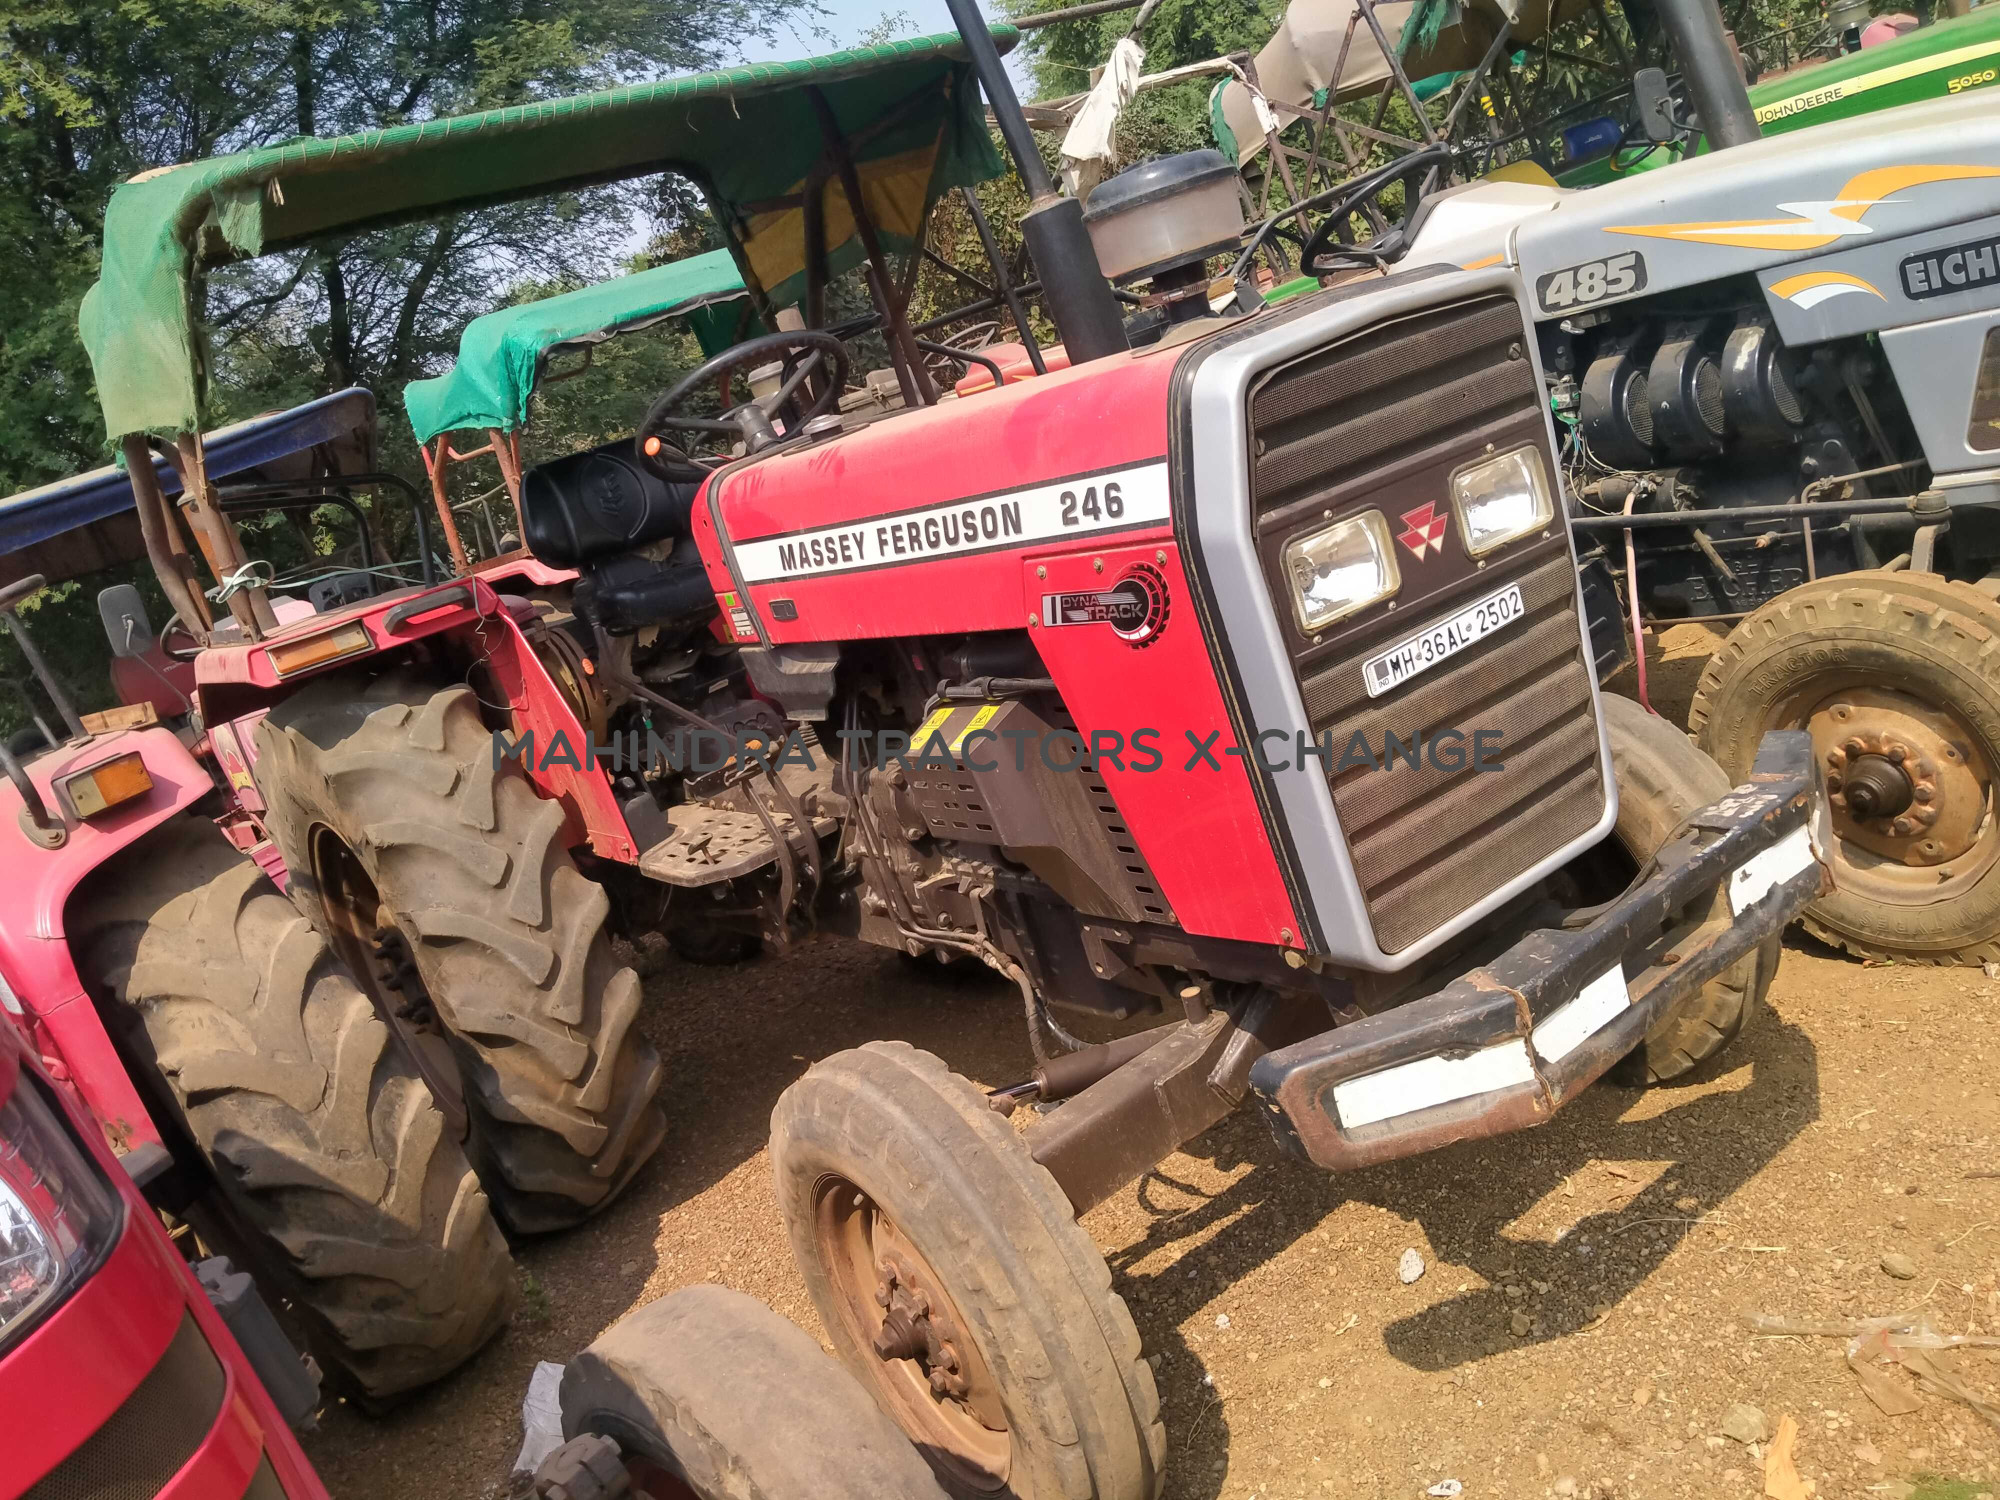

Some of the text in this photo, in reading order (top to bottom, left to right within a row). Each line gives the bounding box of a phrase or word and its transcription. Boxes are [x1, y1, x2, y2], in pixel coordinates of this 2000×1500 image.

[1947, 70, 1996, 94] 5050
[1757, 88, 1843, 124] JOHN DEERE
[1544, 254, 1637, 307] 485
[1905, 244, 2000, 294] EICH
[778, 482, 1125, 572] MASSEY FERGUSON 246
[1062, 595, 1101, 608] DYNA
[1084, 603, 1144, 620] TRACK
[1476, 591, 1521, 634] 2502
[1748, 647, 1849, 696] TRACTOR
